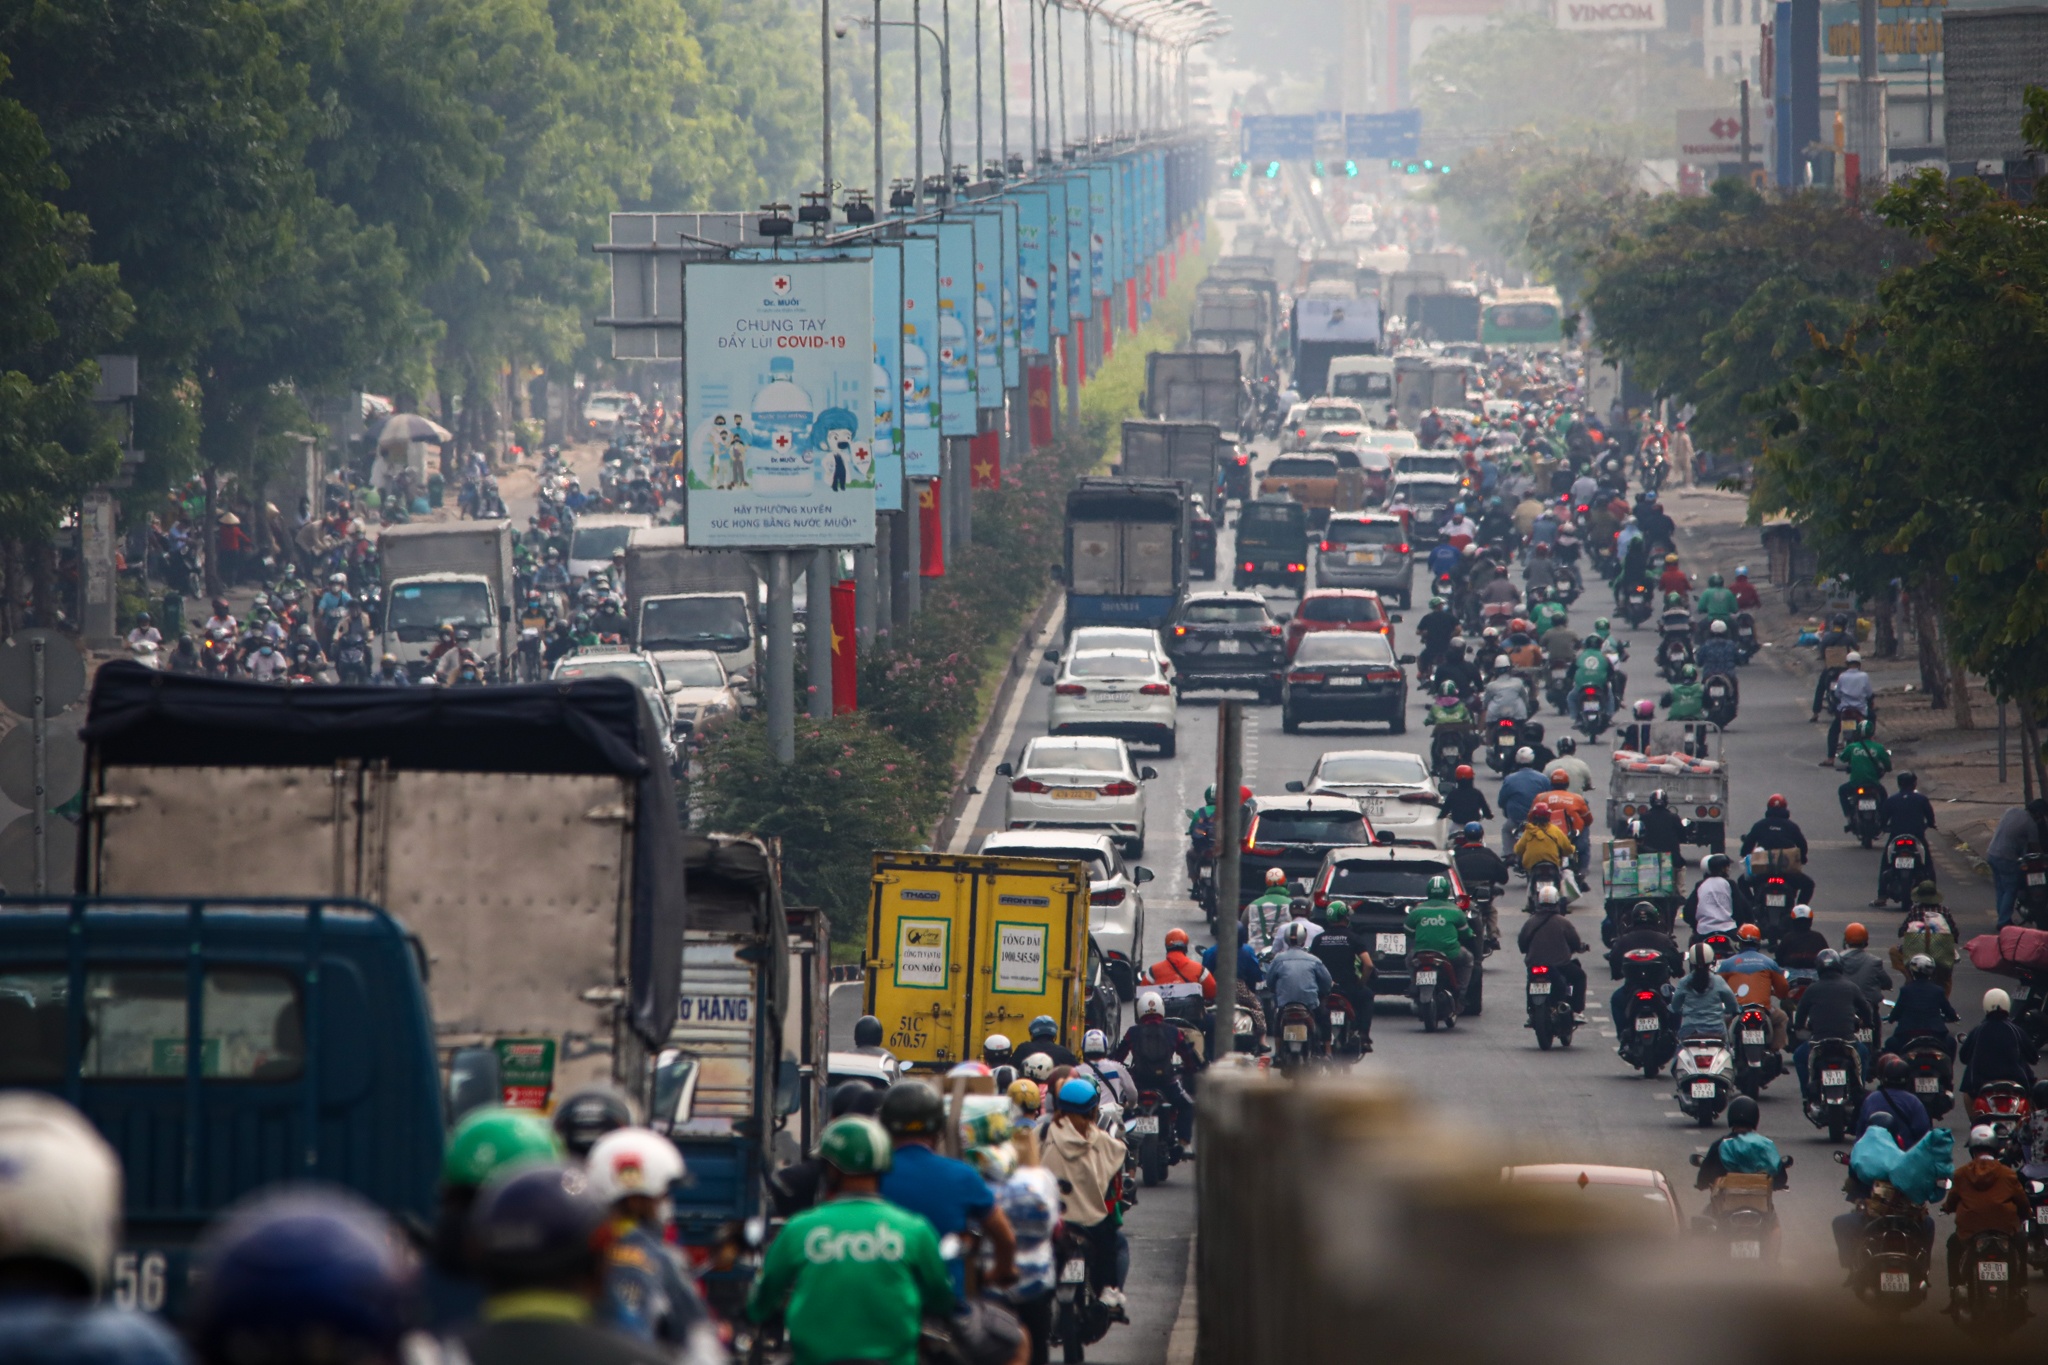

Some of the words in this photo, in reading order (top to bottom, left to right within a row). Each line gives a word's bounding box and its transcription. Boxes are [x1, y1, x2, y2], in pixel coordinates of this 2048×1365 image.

[1568, 3, 1654, 21] VINCOM
[763, 299, 776, 307] Dr.
[736, 318, 794, 332] CHUNG
[799, 318, 827, 331] TAY
[718, 332, 746, 348] ĐẨY
[751, 334, 773, 348] LÙI
[777, 335, 846, 348] COVID-19
[733, 503, 752, 514] HÃY
[755, 503, 798, 514] THƯỜNG
[800, 503, 832, 514] XUYÊN
[711, 517, 729, 528] SÚC
[732, 519, 760, 529] HỌNG
[764, 517, 791, 528] BẰNG
[793, 517, 821, 528] NƯỚC
[904, 891, 938, 900] THACO
[1000, 896, 1048, 906] FRONTIER
[1420, 914, 1446, 926] Grab
[1002, 933, 1025, 946] TỔNG
[902, 963, 920, 971] CON
[698, 996, 748, 1020] HÀNG
[899, 1016, 924, 1032] 51C
[890, 1033, 928, 1049] 670.57
[804, 1222, 905, 1264] Grab
